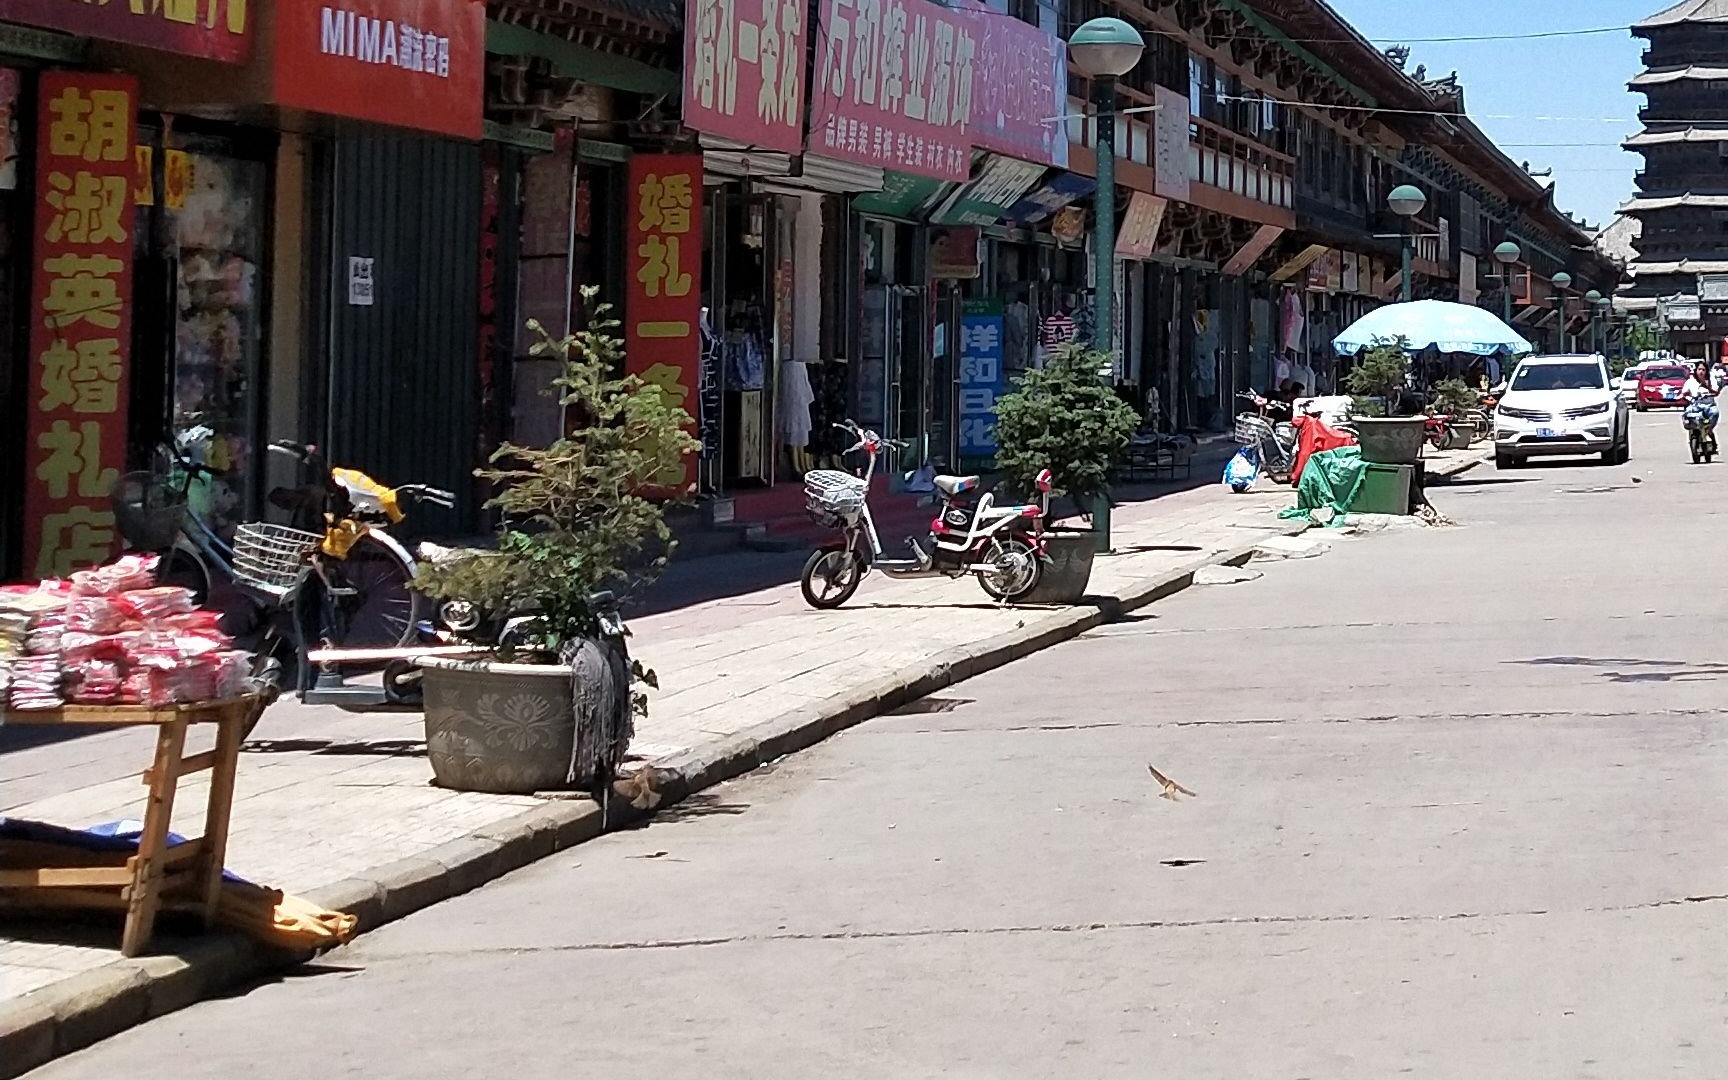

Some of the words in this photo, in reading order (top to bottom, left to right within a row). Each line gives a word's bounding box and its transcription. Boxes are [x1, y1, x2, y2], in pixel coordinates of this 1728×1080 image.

[321, 6, 399, 67] MIMA
[38, 86, 131, 577] 胡淑英婚礼店
